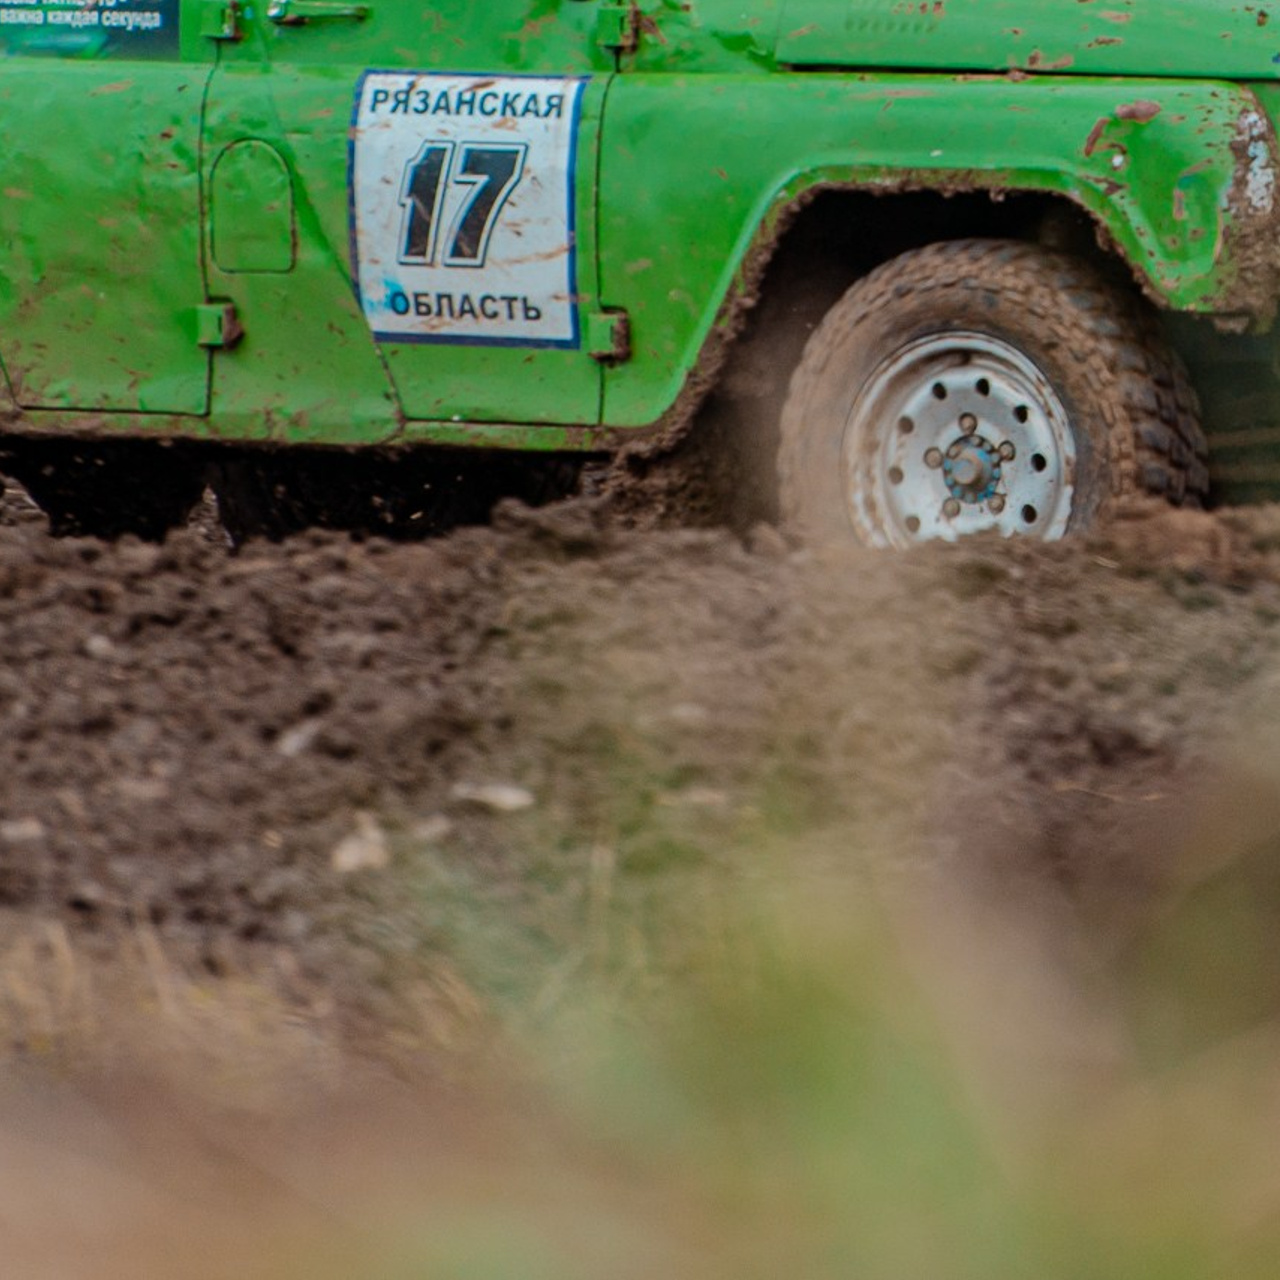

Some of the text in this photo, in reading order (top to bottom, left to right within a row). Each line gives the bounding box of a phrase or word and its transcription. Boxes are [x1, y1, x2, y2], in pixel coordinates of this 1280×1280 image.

[47, 10, 99, 28] каждая
[101, 11, 161, 31] секунда
[370, 89, 564, 118] РЯЗАНСКАЯ
[397, 139, 529, 268] 17
[391, 291, 542, 320] ОБЛАСТЬ
